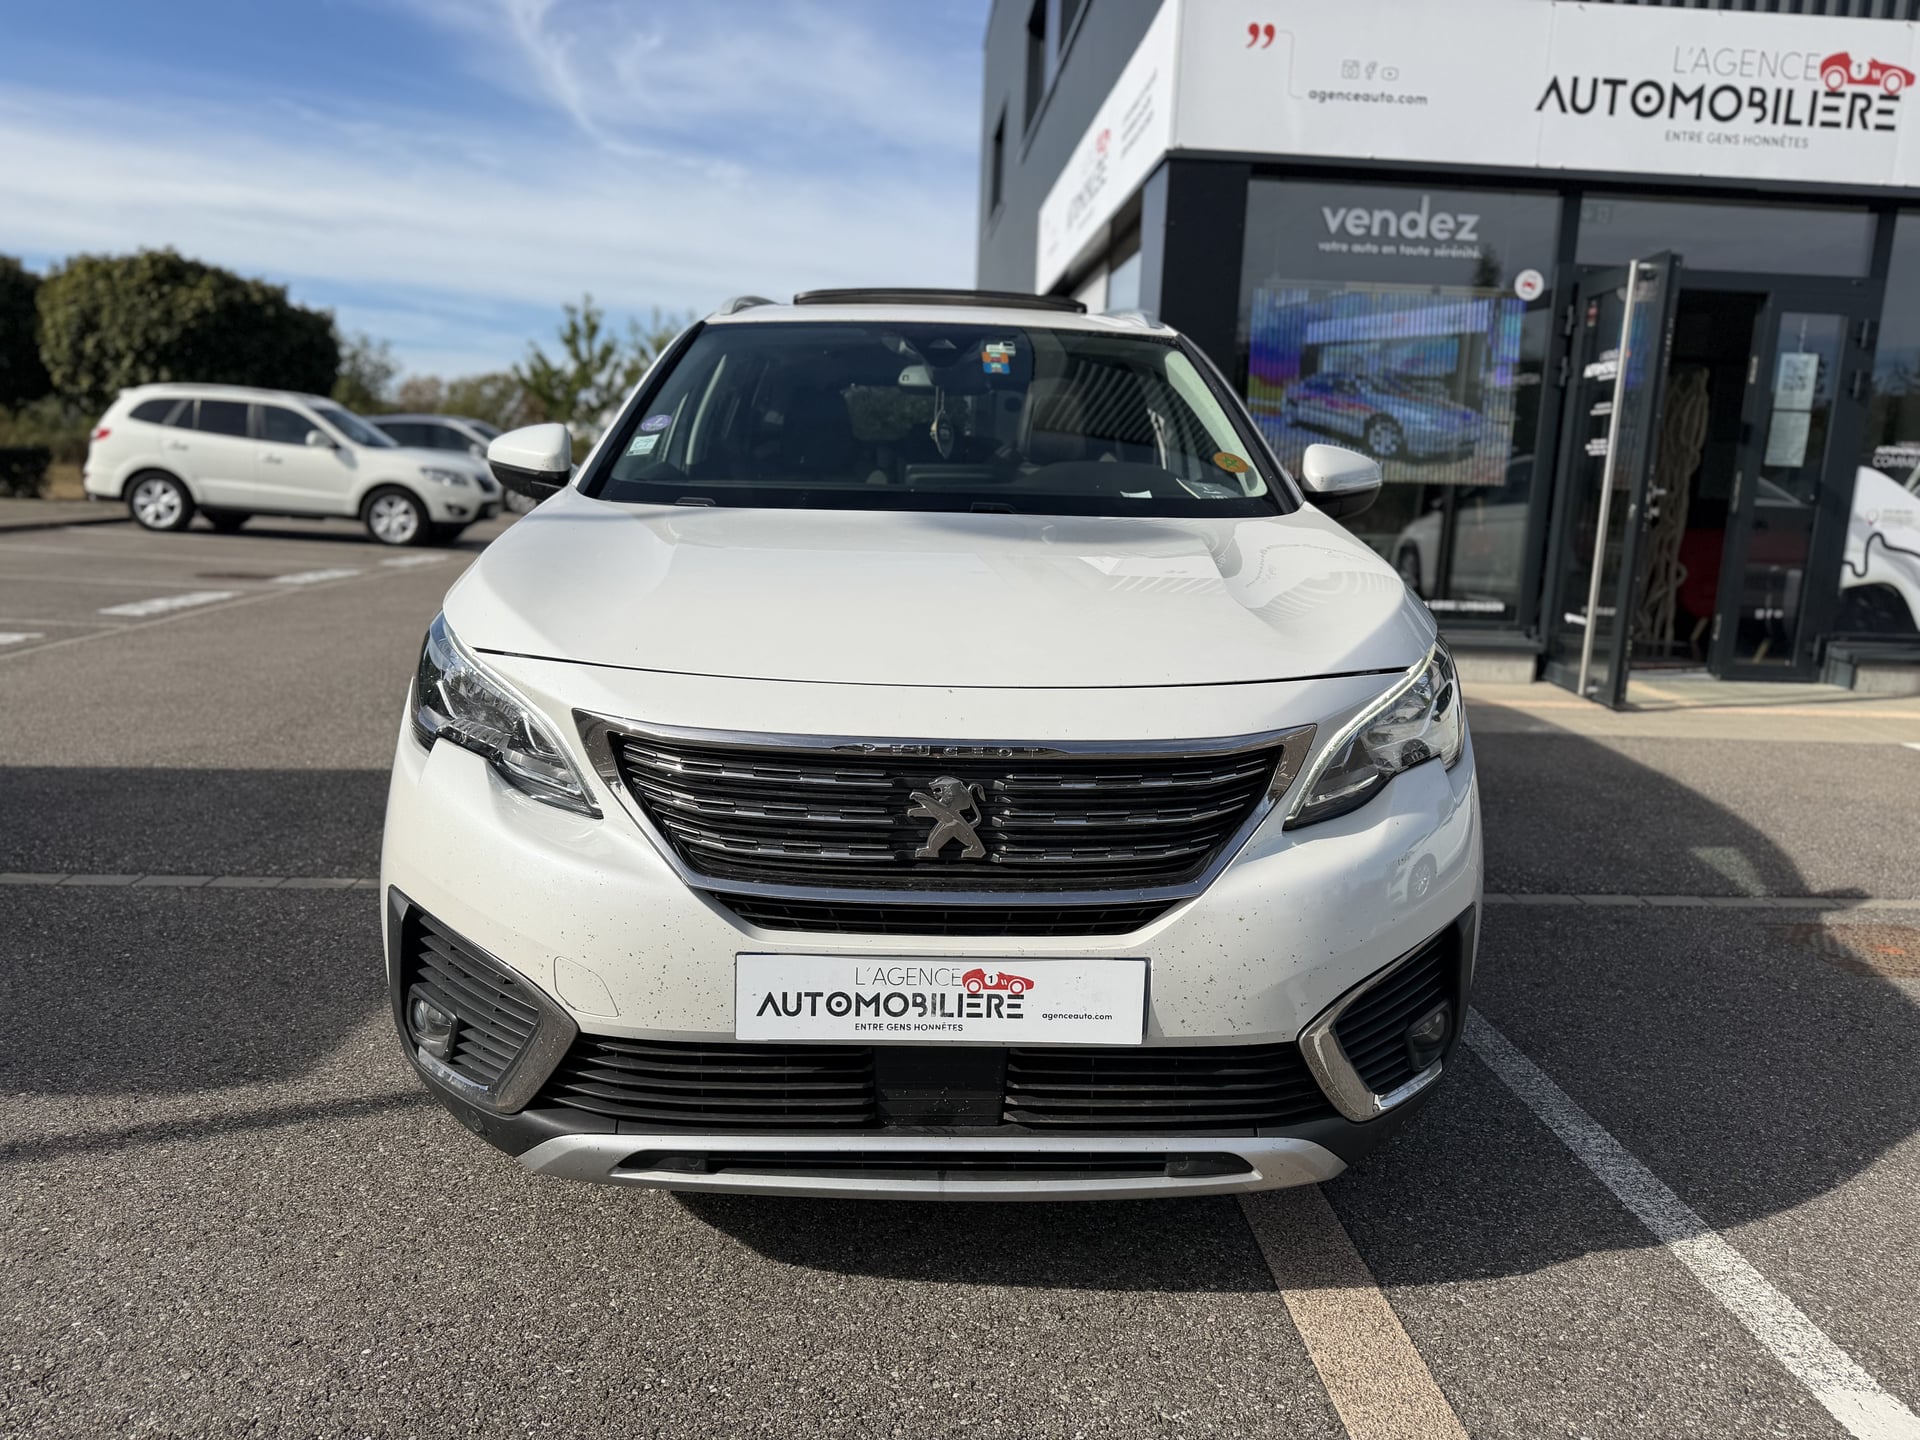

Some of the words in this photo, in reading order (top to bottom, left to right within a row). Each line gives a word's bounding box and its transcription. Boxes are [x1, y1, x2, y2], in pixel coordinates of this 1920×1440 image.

[1672, 45, 1821, 81] L'AGENCE
[1308, 90, 1428, 104] agenceauto.com
[1665, 129, 1701, 143] ENTRE
[1706, 132, 1740, 145] GENS
[1743, 133, 1809, 149] HONNÊTES
[1322, 195, 1480, 242] vendez
[1318, 241, 1348, 253] votre
[1351, 243, 1379, 255] auto
[1381, 246, 1397, 255] en
[1400, 244, 1430, 257] toute
[862, 743, 1039, 758] PEUGEOT
[855, 967, 962, 986] L'AGENCE
[988, 975, 993, 983] 1
[855, 1023, 884, 1031] ENTRE
[887, 1023, 912, 1031] GENS
[914, 1022, 964, 1032] HONNÊTES
